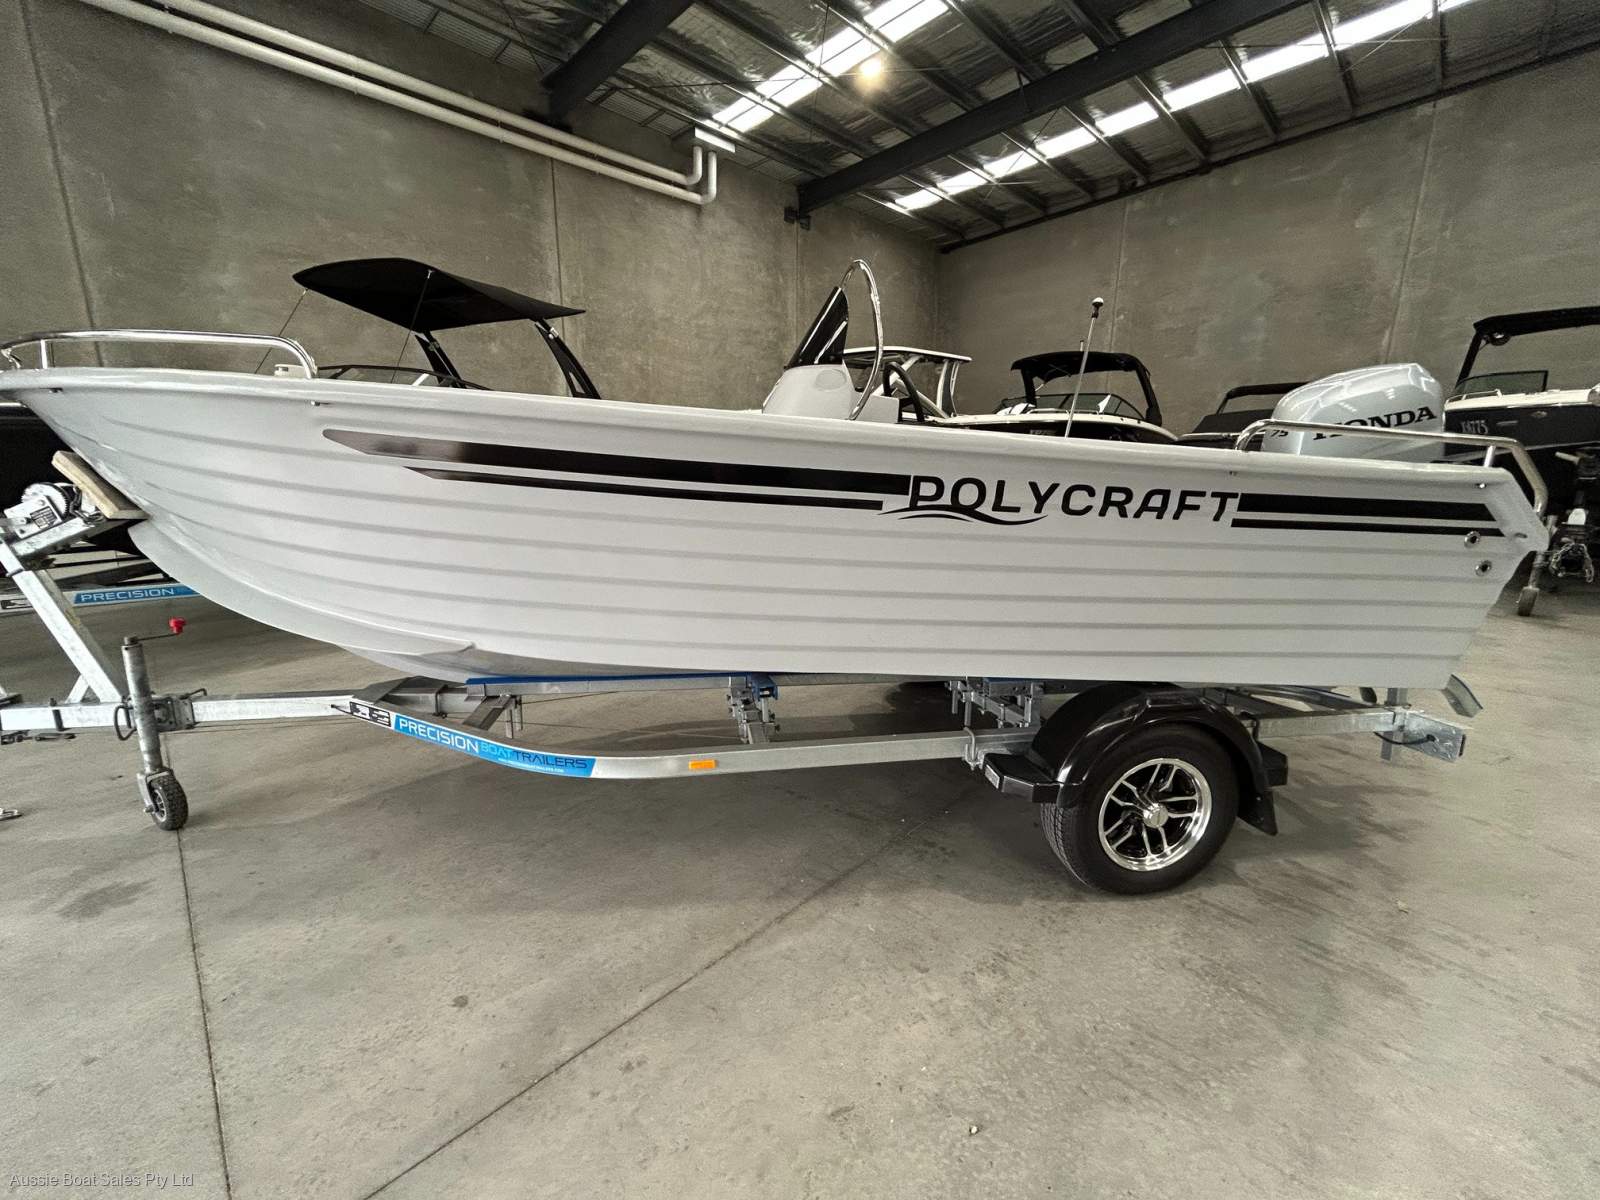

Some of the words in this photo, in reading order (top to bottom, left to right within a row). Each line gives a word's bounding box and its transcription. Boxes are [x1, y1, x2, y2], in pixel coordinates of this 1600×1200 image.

[1313, 406, 1437, 440] NDA
[909, 475, 1239, 521] POLYCRAFT
[80, 588, 175, 602] PRECISION
[399, 718, 480, 754] PRECISION
